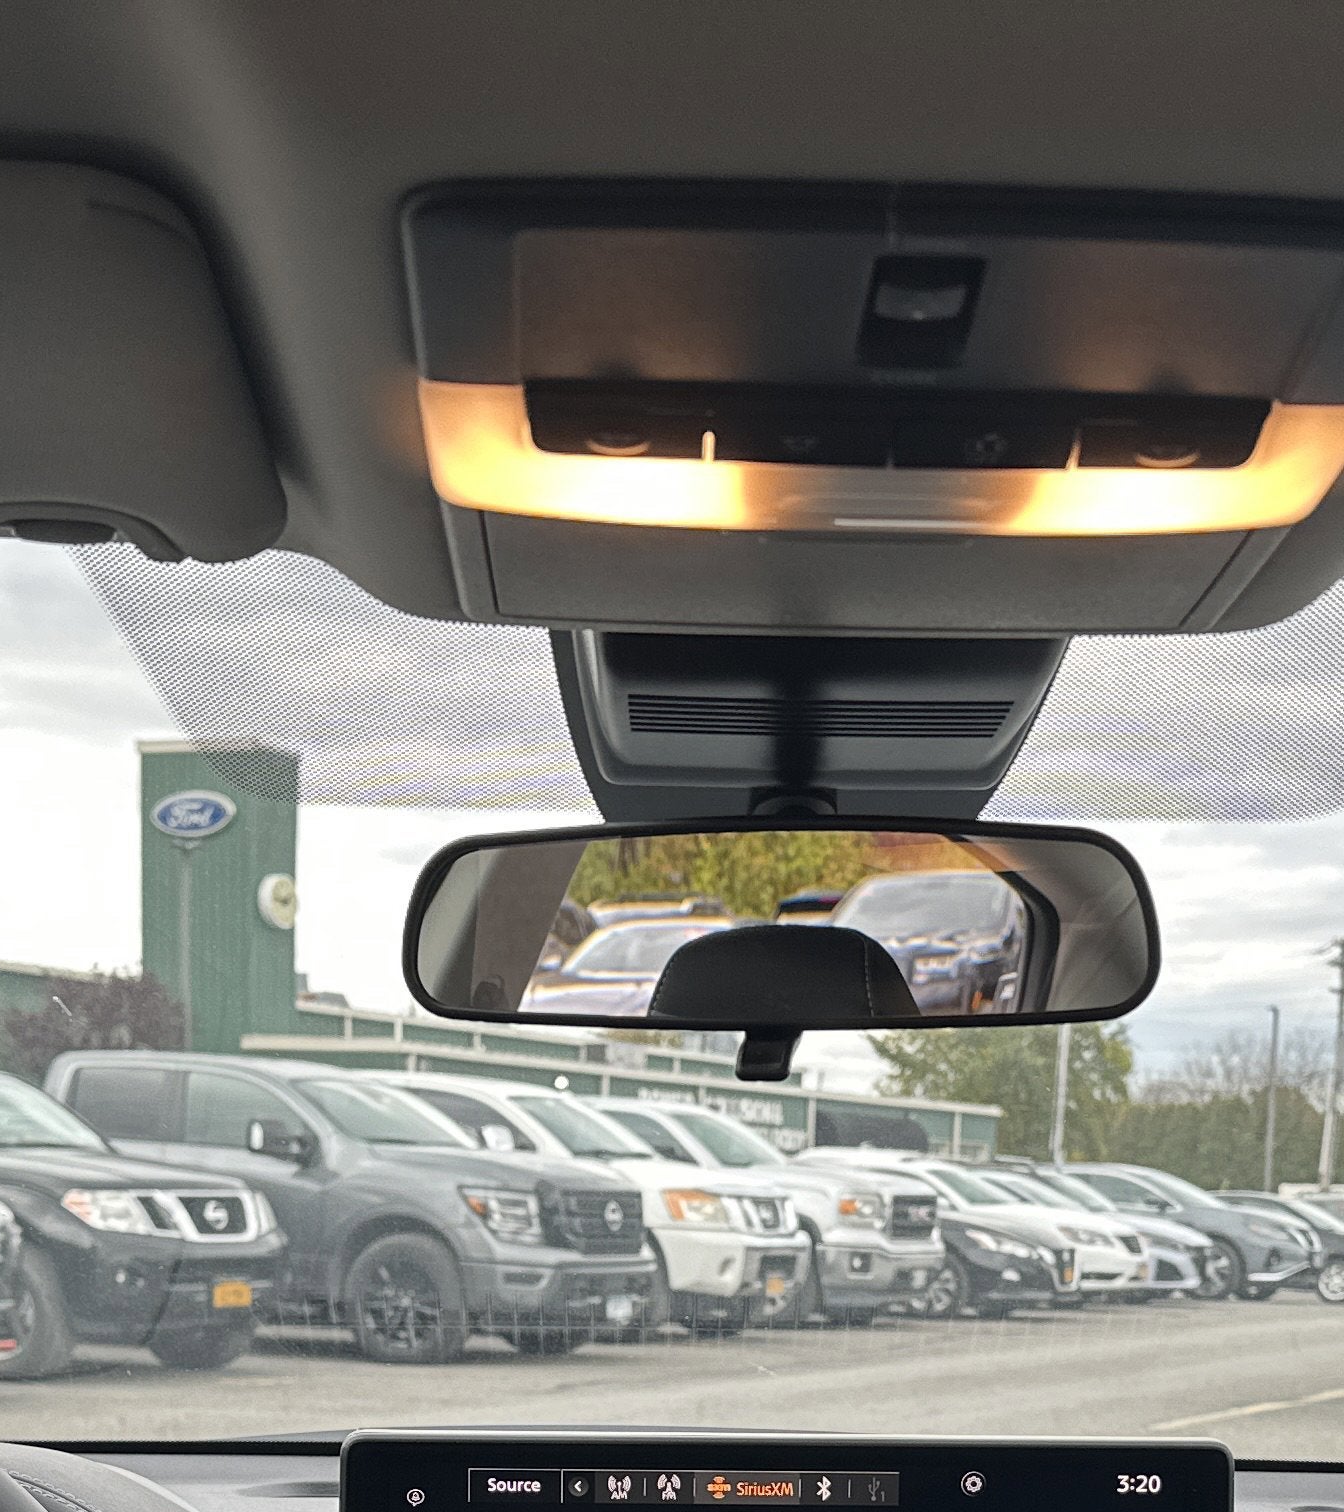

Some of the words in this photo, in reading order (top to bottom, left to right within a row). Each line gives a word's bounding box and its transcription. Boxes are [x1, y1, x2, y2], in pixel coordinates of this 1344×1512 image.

[487, 1477, 541, 1492] Source
[736, 1481, 793, 1497] SiriusXM
[1116, 1475, 1161, 1493] 3:20
